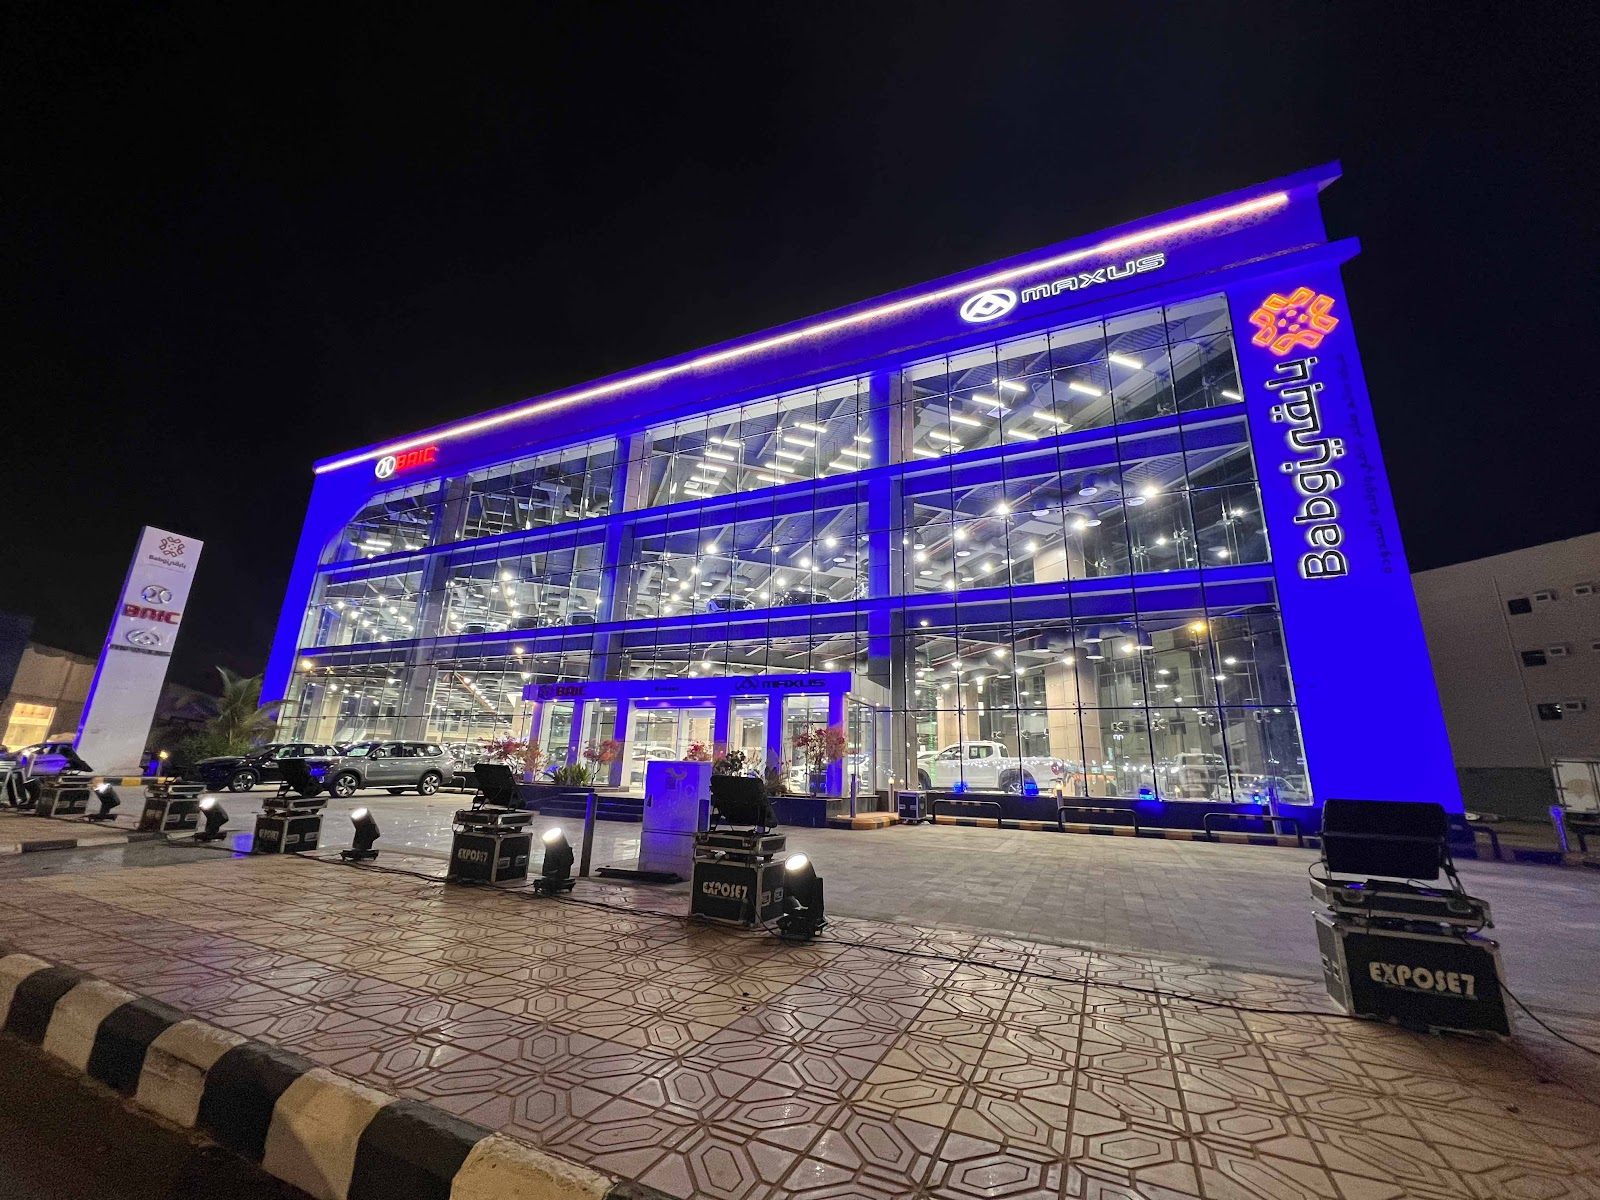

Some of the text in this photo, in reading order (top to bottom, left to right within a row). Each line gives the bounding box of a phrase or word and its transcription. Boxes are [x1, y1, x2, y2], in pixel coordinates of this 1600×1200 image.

[1021, 253, 1165, 303] MAXUS
[1266, 356, 1344, 468] بابقي
[395, 446, 438, 472] BAIC
[1283, 455, 1349, 579] Babgi
[121, 604, 181, 625] BAIC
[702, 880, 748, 900] EXPOSE7
[1368, 961, 1475, 996] EXPOSE7
